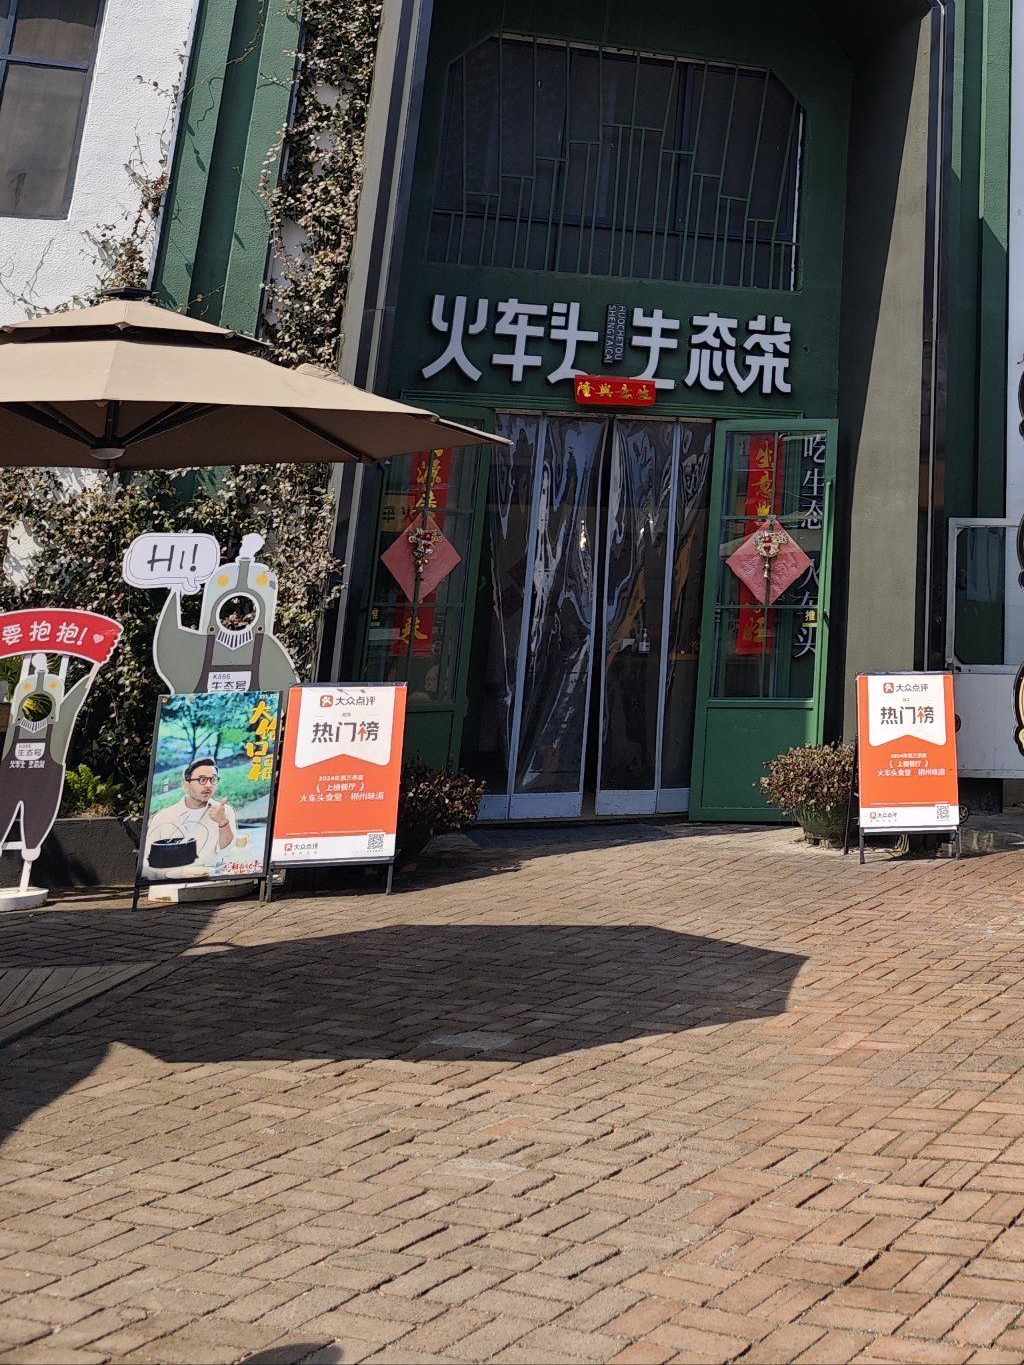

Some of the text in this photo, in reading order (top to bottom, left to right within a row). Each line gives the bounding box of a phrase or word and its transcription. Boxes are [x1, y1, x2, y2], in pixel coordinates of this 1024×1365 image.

[603, 305, 617, 364] SHENGTAICAI
[614, 305, 627, 360] HUOCHETOU
[896, 684, 929, 692] 大众点评
[335, 696, 376, 706] 大众点评
[880, 706, 935, 725] 热门榜
[311, 721, 380, 743] 热门榜
